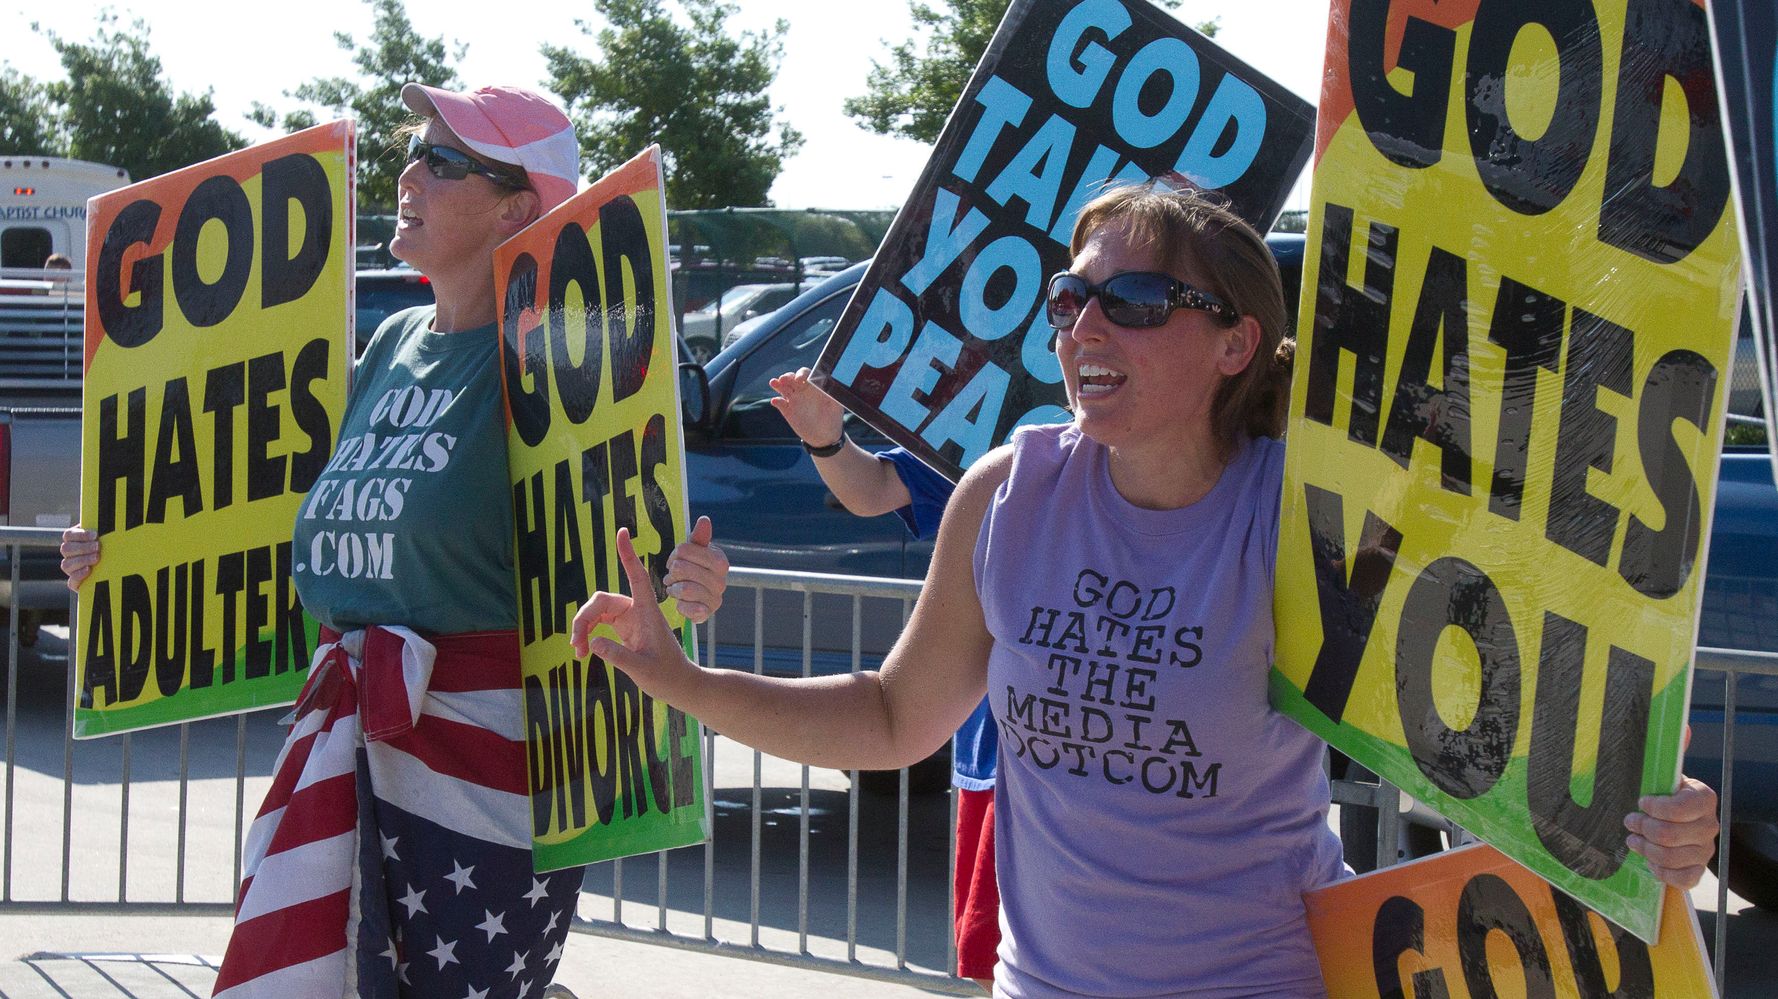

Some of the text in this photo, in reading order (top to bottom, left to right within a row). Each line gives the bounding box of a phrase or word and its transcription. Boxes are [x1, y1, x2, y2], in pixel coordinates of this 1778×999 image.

[1046, 0, 1267, 190] GOD
[1348, 0, 1732, 265] GOD
[97, 153, 333, 348] GOD
[503, 195, 656, 447] GOD
[98, 338, 332, 537] HATES
[321, 432, 457, 476] HATES
[369, 385, 453, 428] GOD
[1304, 202, 1719, 599] HATES
[296, 531, 395, 579] .COM
[304, 478, 412, 521] FAGS
[513, 413, 676, 647] HATES
[80, 541, 321, 709] ADULTER
[1019, 606, 1203, 668] HATES
[1073, 569, 1175, 621] GOD
[525, 627, 694, 837] DIVORCE
[1006, 685, 1202, 757] MEDIA
[1047, 653, 1157, 712] THE
[1304, 483, 1656, 880] YOU
[1373, 874, 1655, 999] GOD
